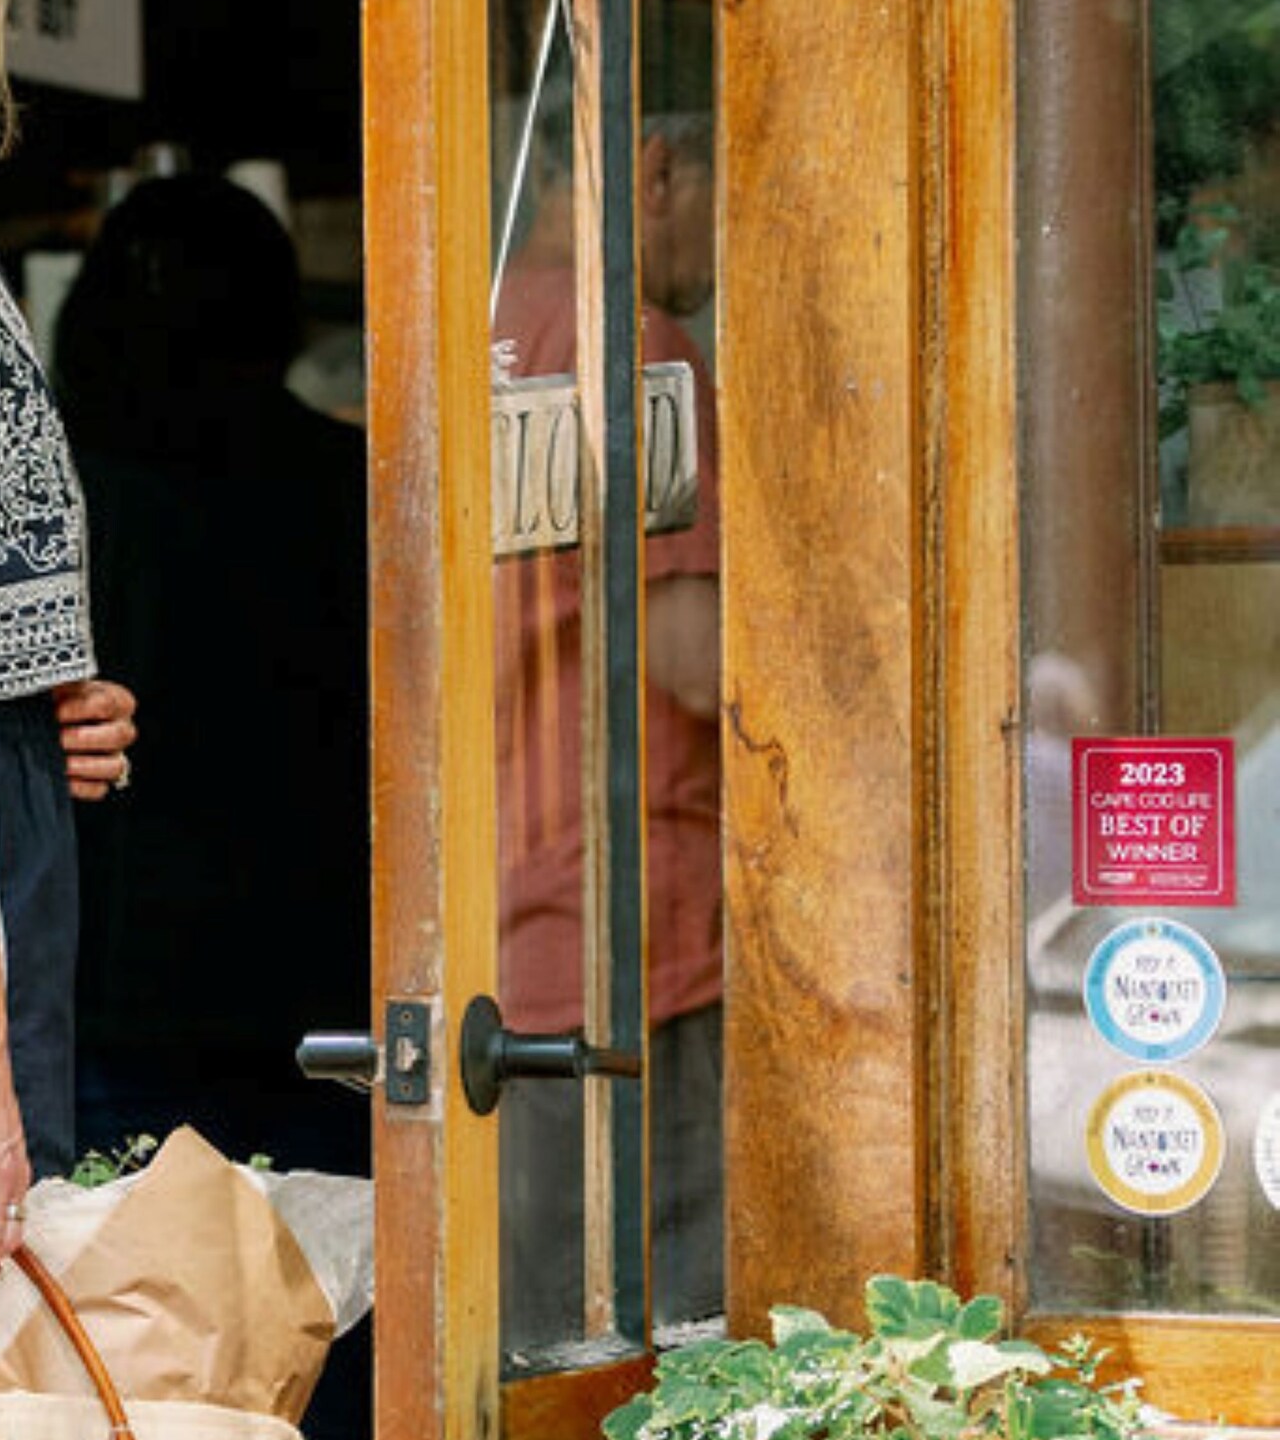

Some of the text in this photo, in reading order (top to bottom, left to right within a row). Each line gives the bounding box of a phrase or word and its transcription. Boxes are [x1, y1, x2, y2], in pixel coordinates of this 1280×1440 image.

[1119, 762, 1186, 786] 2023
[1091, 792, 1212, 810] CAPE COD LIFE
[1099, 812, 1208, 837] BEST OF
[1105, 841, 1198, 862] WINNER
